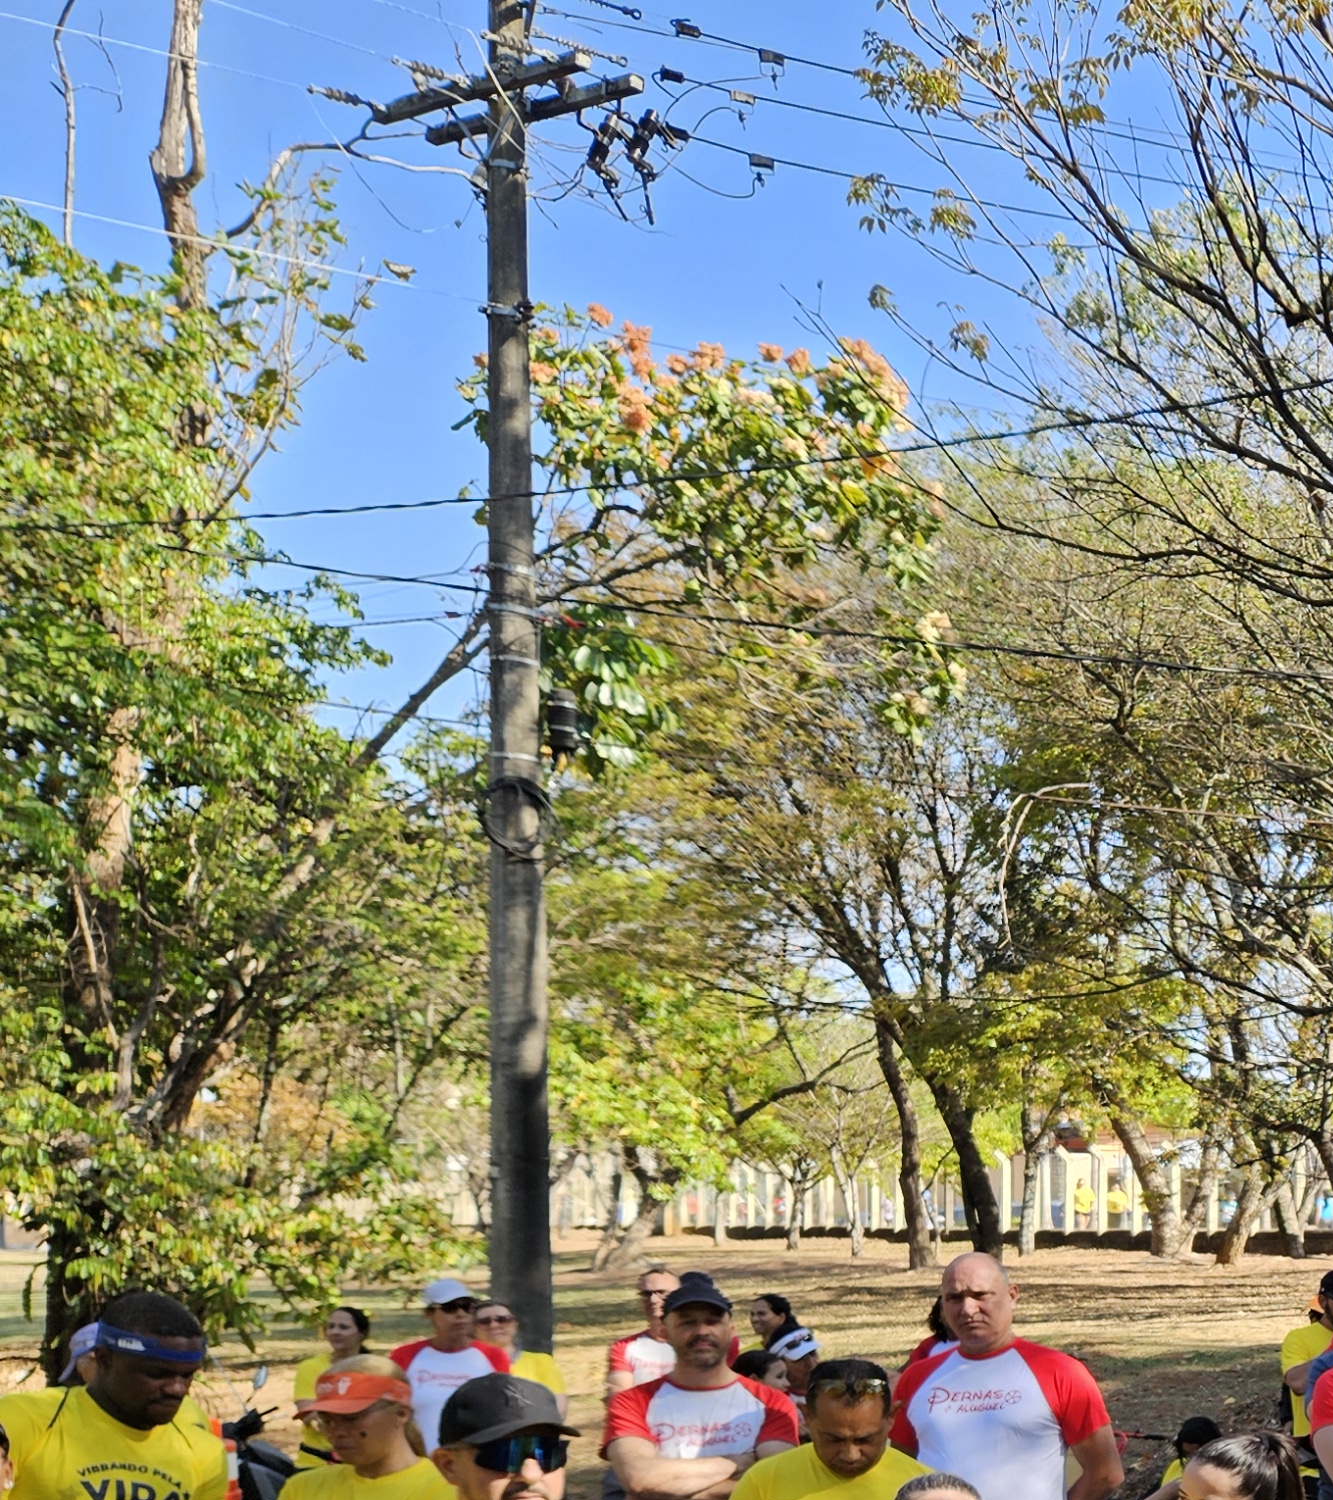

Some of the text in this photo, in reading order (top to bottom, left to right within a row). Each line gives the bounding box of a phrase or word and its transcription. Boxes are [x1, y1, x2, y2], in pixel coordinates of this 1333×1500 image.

[928, 1387, 1003, 1413] PERNAS
[956, 1402, 1005, 1413] ALUGUEL
[152, 1467, 181, 1489] PELA
